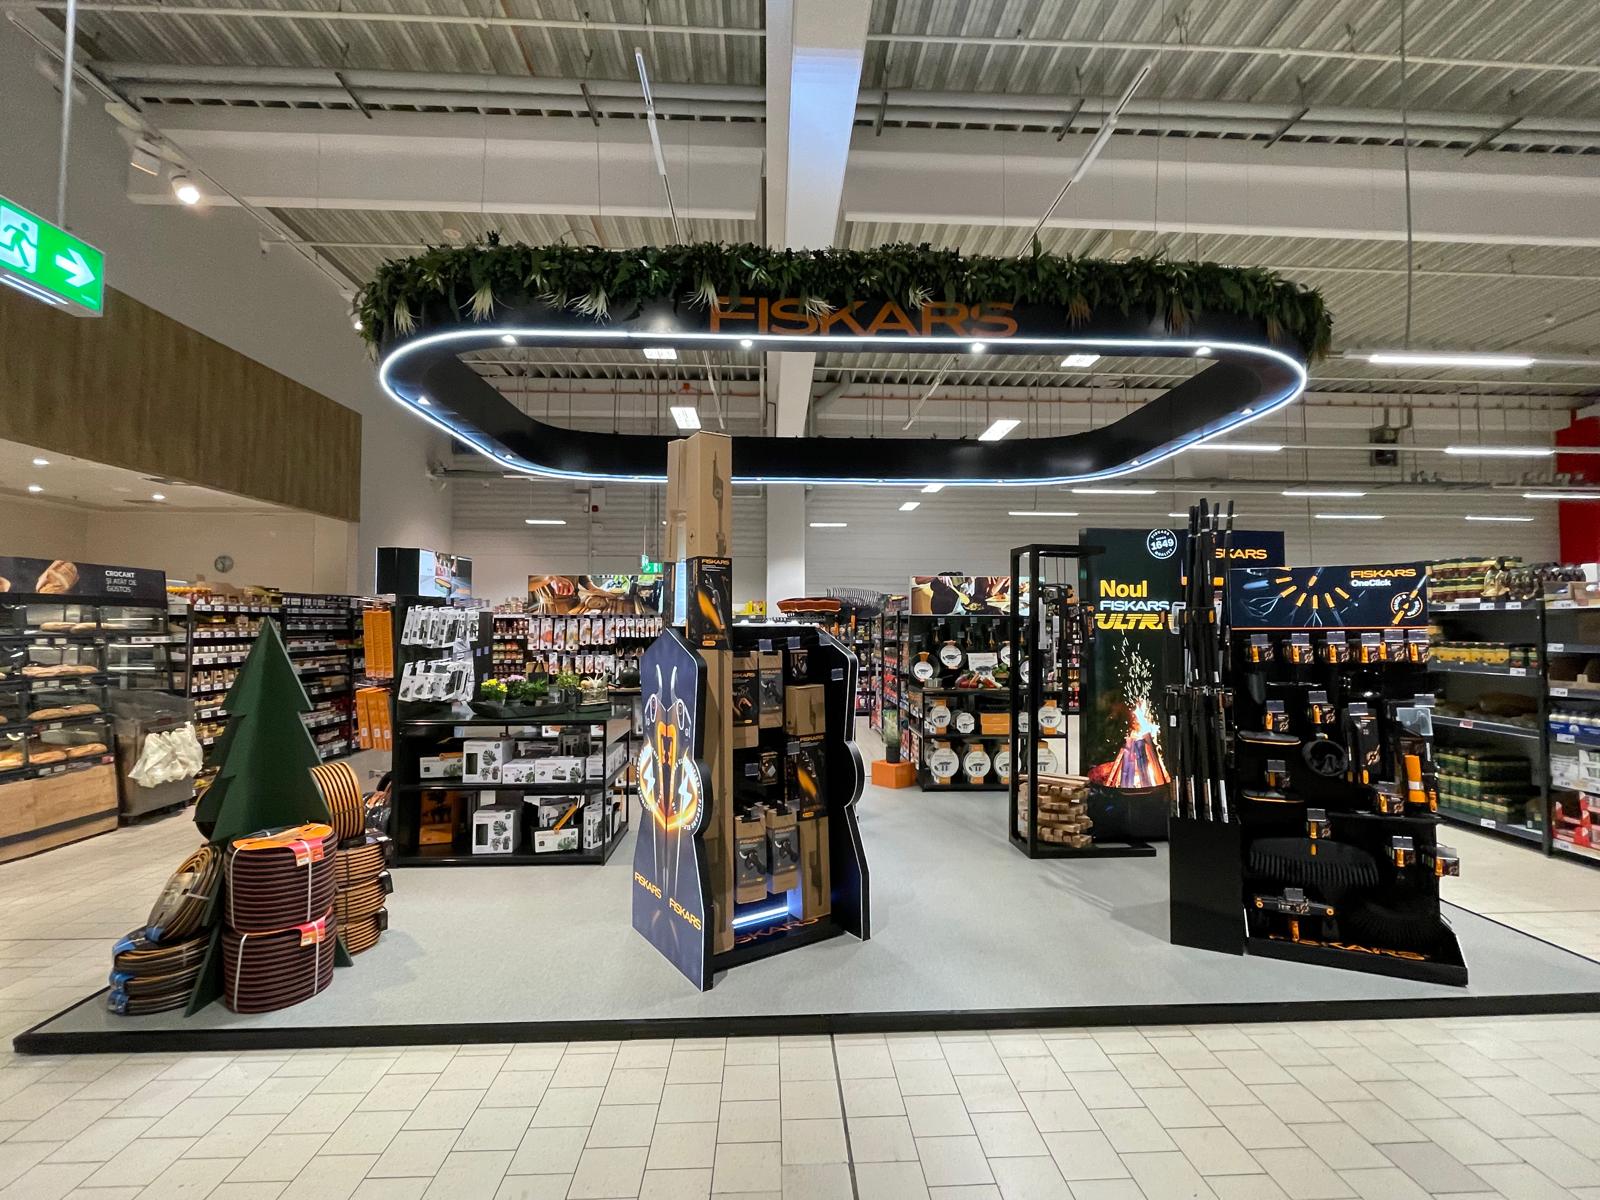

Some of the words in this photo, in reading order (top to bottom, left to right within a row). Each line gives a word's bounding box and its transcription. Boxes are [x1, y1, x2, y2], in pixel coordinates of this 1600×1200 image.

[709, 296, 1018, 337] FISKARS
[1151, 538, 1174, 551] 1649
[1215, 548, 1268, 560] SKARS
[1350, 568, 1417, 579] FISKARS
[1100, 580, 1147, 598] Noul
[1351, 578, 1391, 587] OneClick
[1100, 600, 1170, 611] FISKARS
[634, 872, 662, 899] FISKARS
[669, 897, 702, 930] FISKARS
